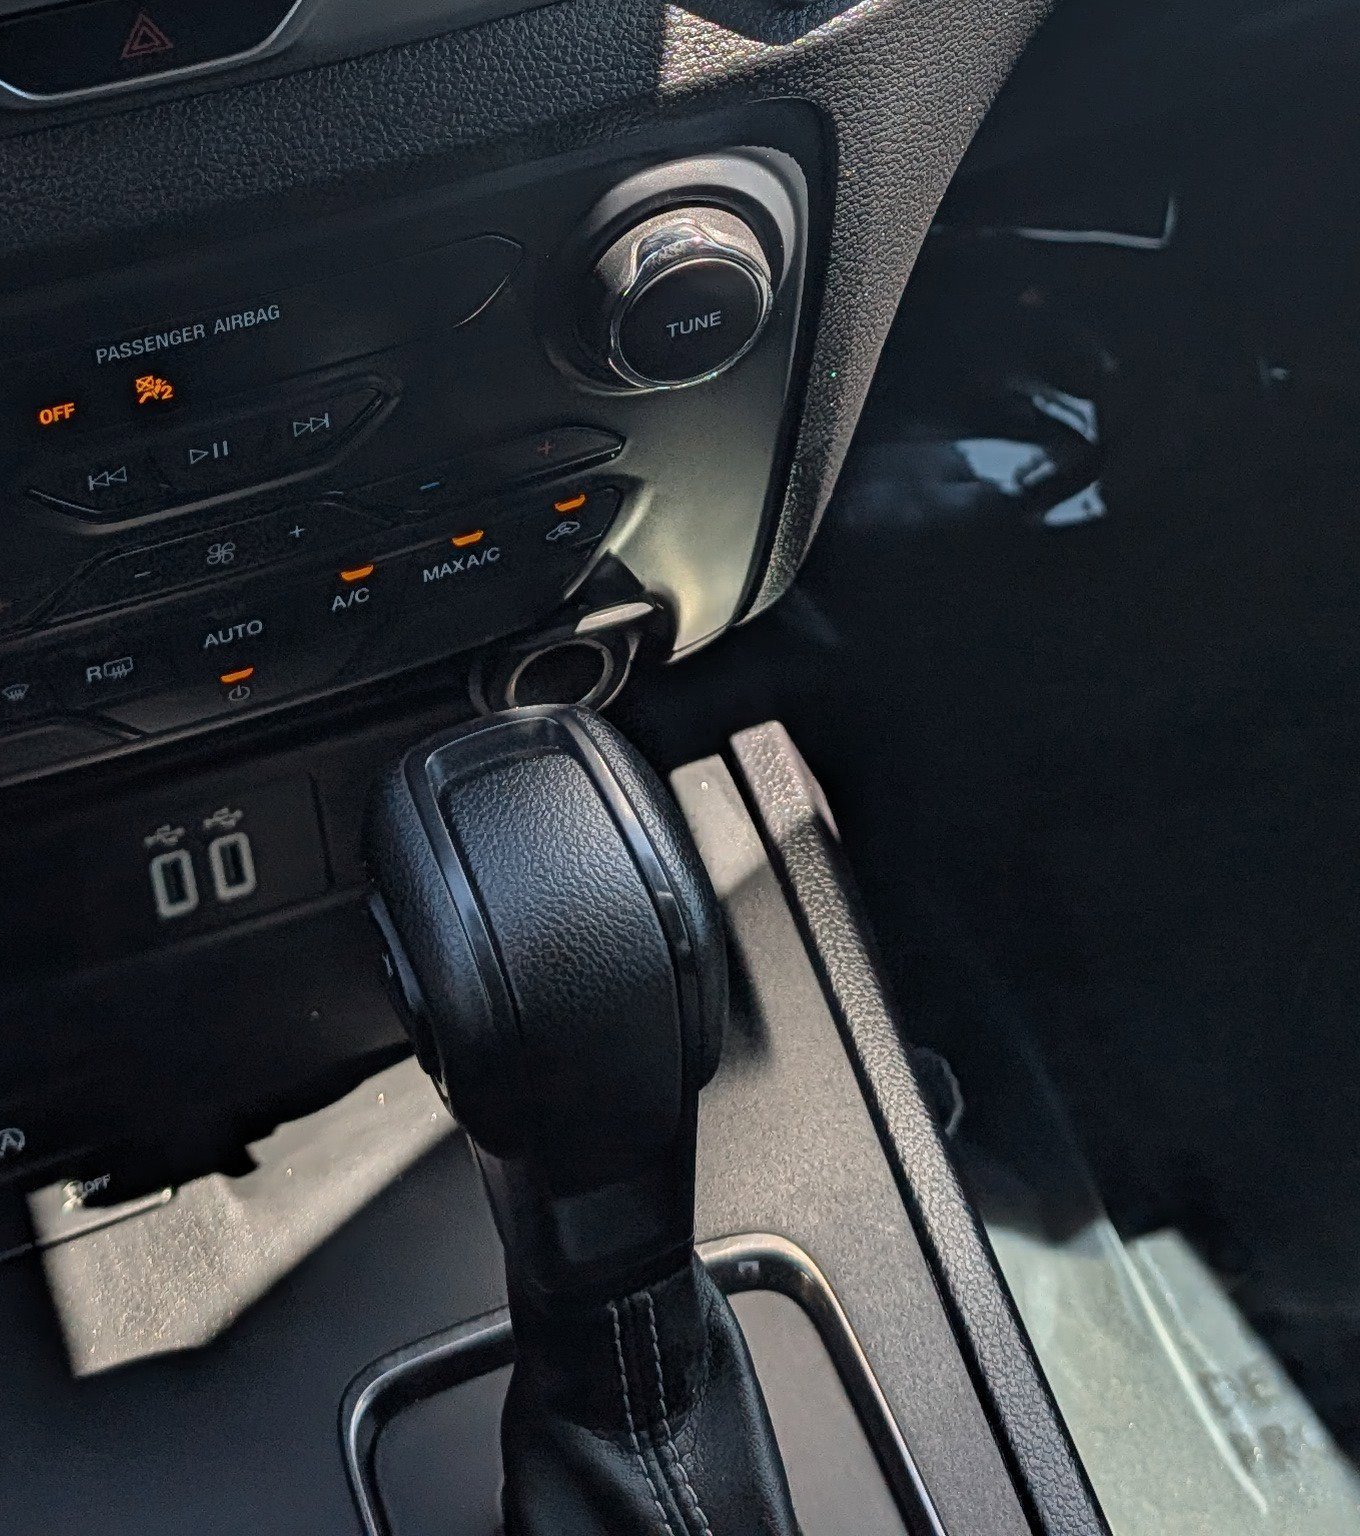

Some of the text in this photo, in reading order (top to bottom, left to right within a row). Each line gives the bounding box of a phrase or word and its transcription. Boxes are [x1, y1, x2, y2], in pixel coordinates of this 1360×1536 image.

[95, 304, 281, 365] PASSENGER AIRBAG
[665, 311, 723, 340] TUNE
[39, 402, 76, 426] OFF
[422, 547, 501, 583] MAX A/C
[330, 586, 371, 612] A/C
[203, 619, 263, 649] AUTO
